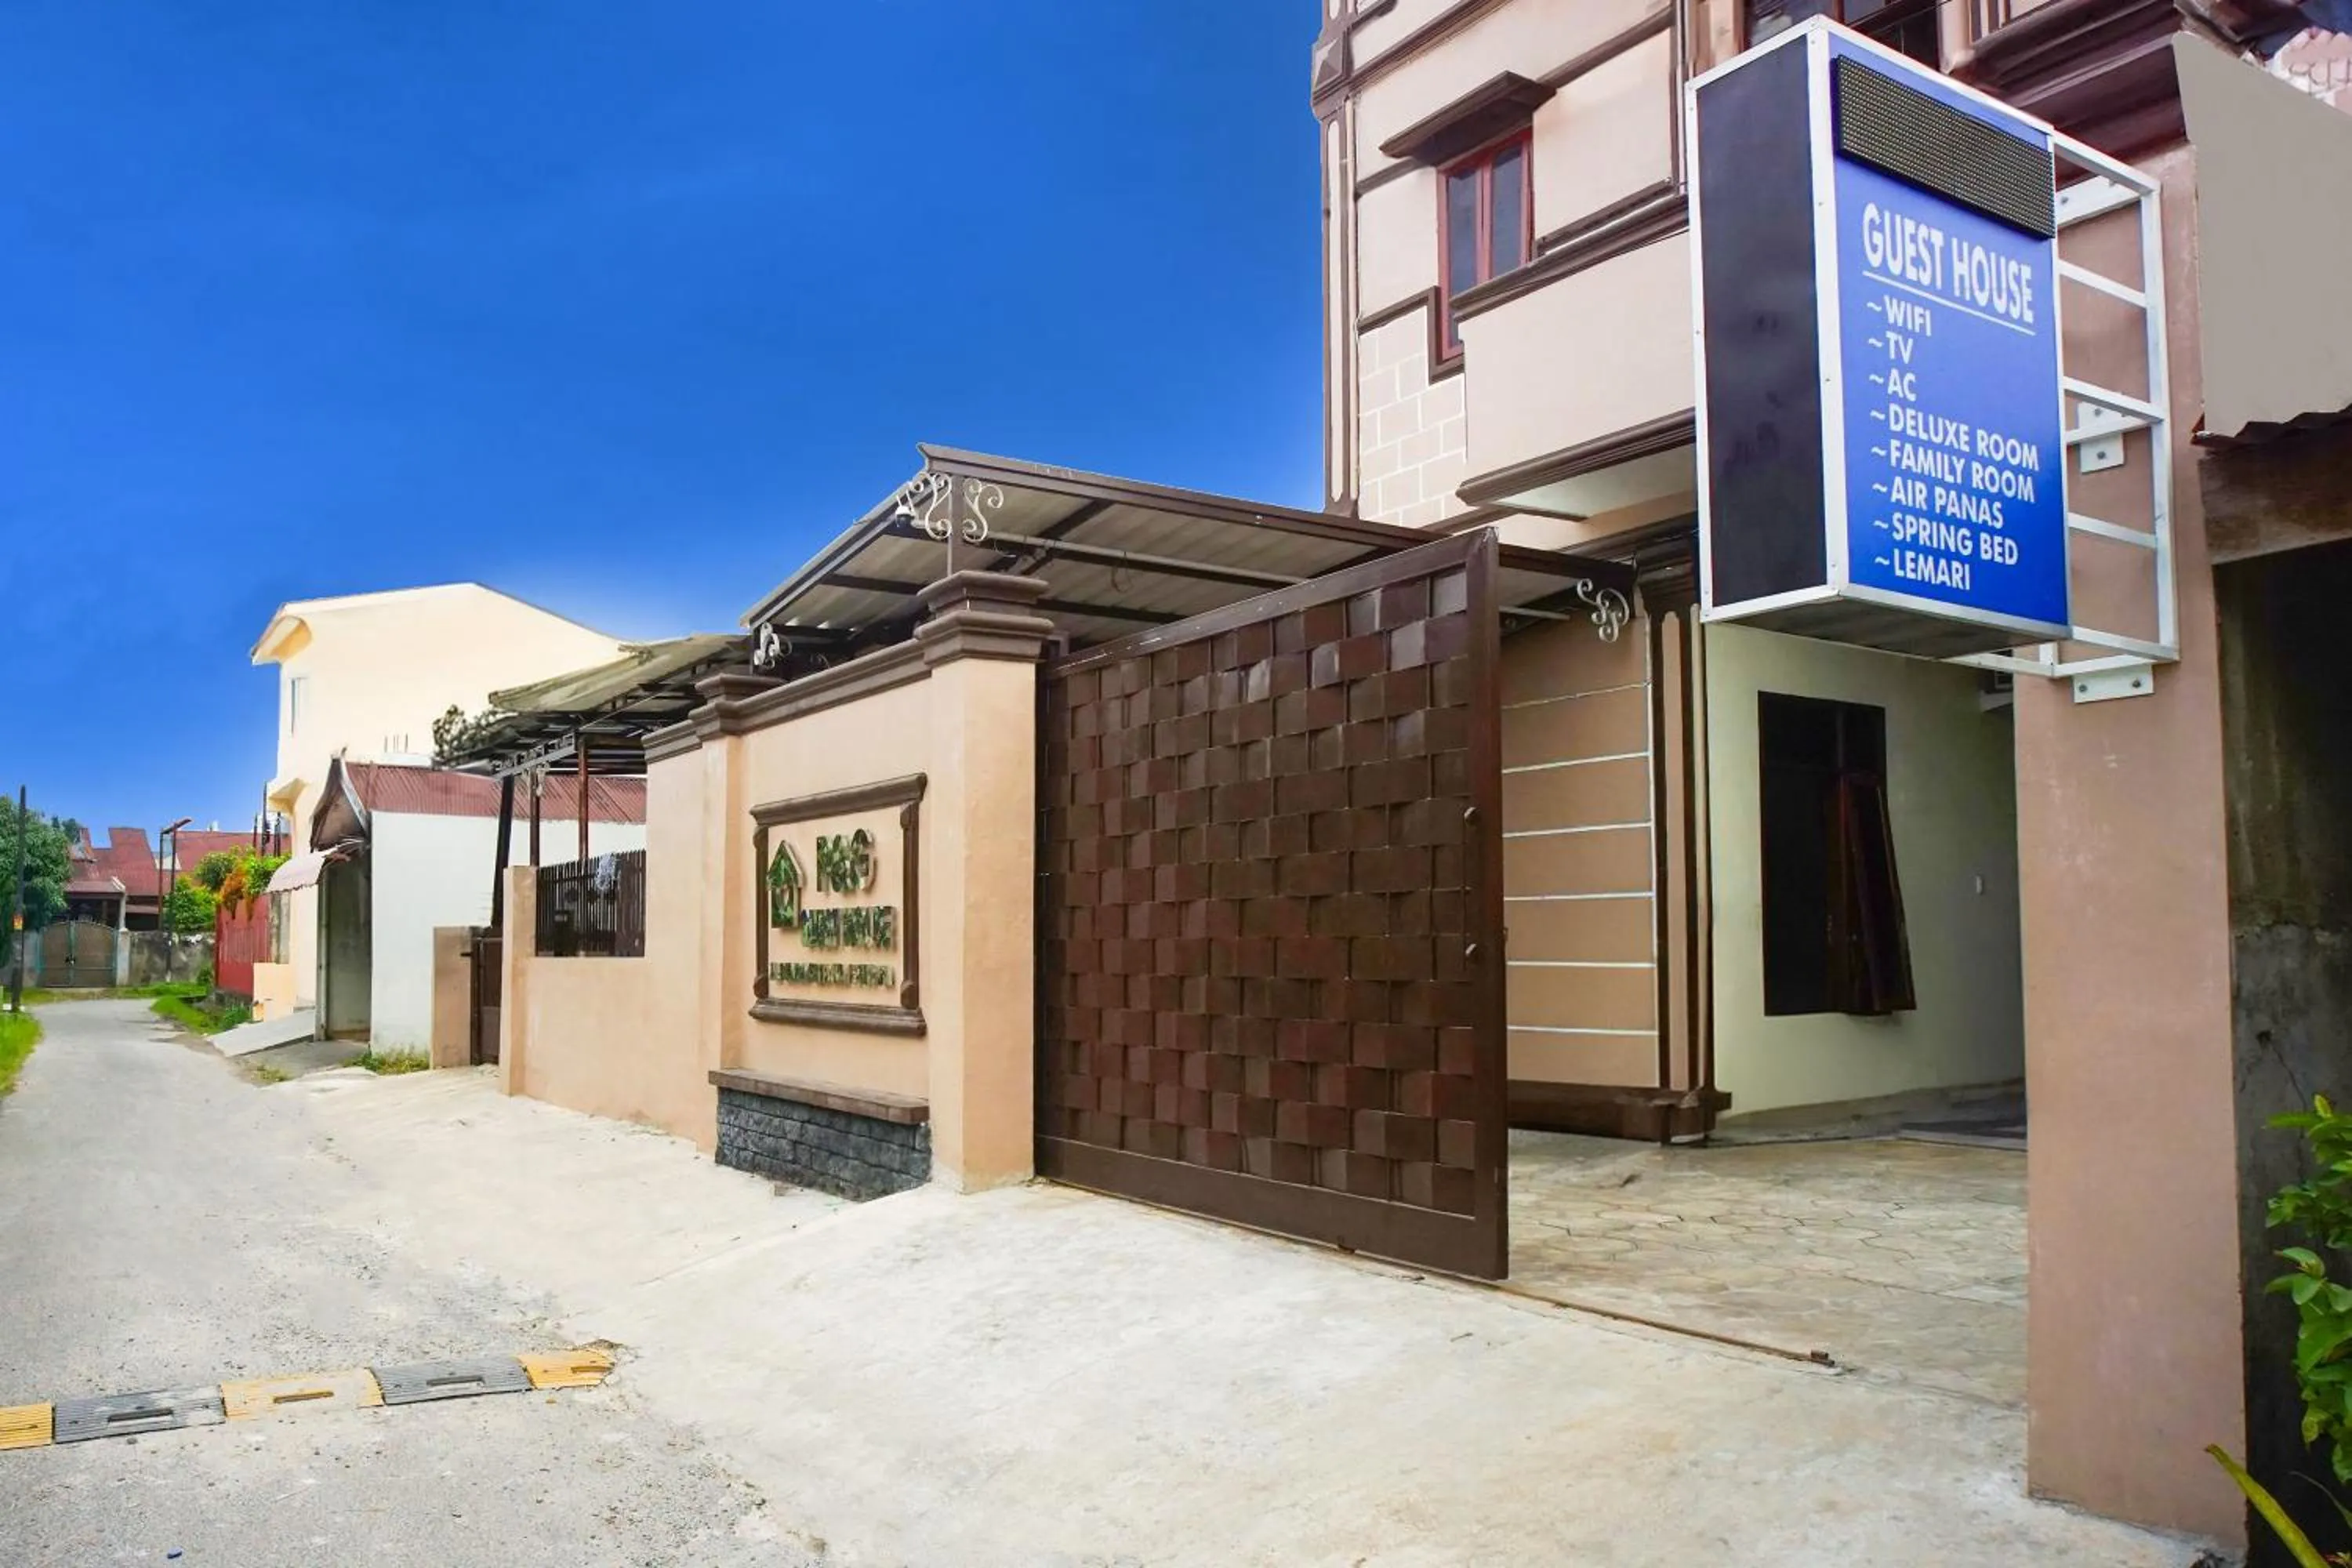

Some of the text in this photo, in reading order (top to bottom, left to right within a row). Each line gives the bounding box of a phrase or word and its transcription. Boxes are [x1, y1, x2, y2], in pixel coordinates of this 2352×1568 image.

[1863, 203, 2034, 323] GUEST HOUSE
[1976, 429, 2038, 470] ROOM
[1972, 461, 2035, 503] ROOM
[1934, 486, 2004, 529] PANAS
[1980, 532, 2018, 565] BED
